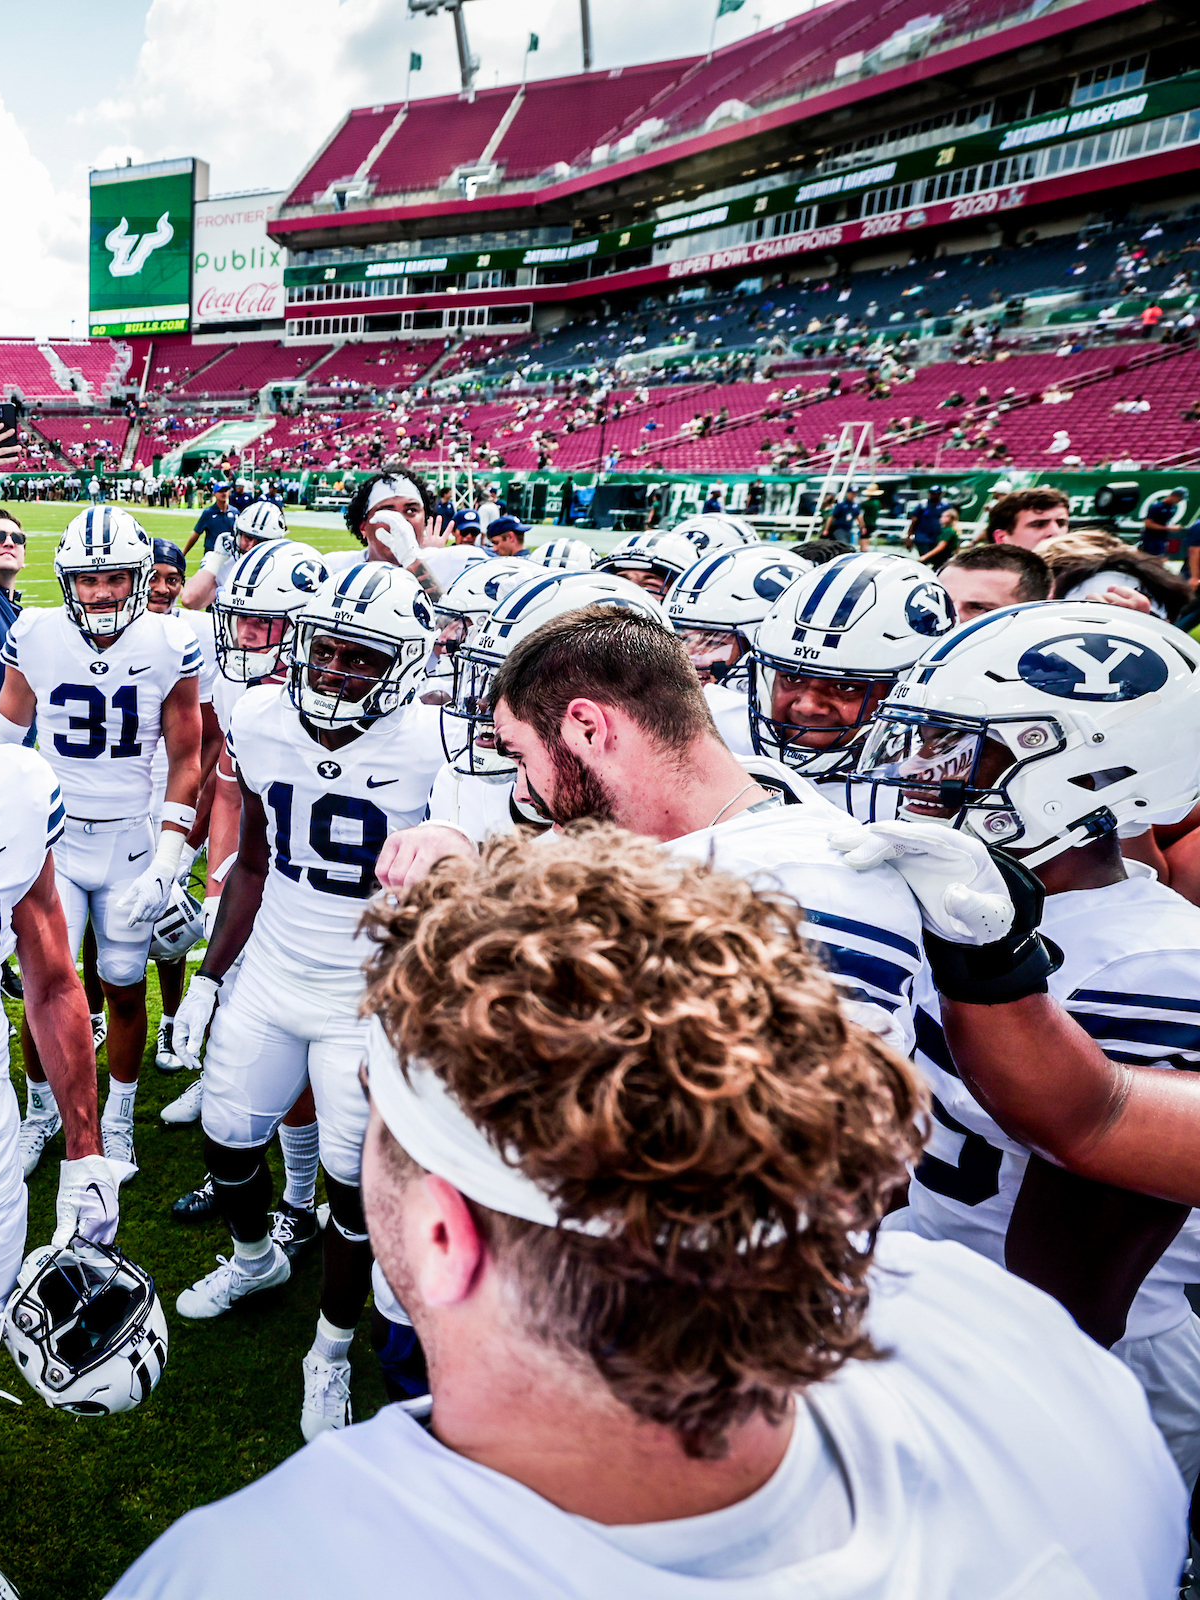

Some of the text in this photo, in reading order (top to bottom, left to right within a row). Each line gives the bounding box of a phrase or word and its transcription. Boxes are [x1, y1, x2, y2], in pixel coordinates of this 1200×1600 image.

[196, 209, 266, 229] FRONTIER
[667, 253, 712, 279] SUPER
[711, 246, 752, 269] BOWL
[753, 227, 843, 261] CHAMPIONS
[859, 214, 903, 240] 2002
[949, 192, 999, 220] 2020
[197, 281, 281, 317] Coca-Cola
[91, 557, 106, 565] BYU
[232, 597, 245, 606] BYU
[479, 635, 495, 649] BYU
[793, 645, 821, 660] BYU
[1037, 637, 1145, 695] Y
[49, 682, 142, 759] 31
[267, 781, 388, 900] 19
